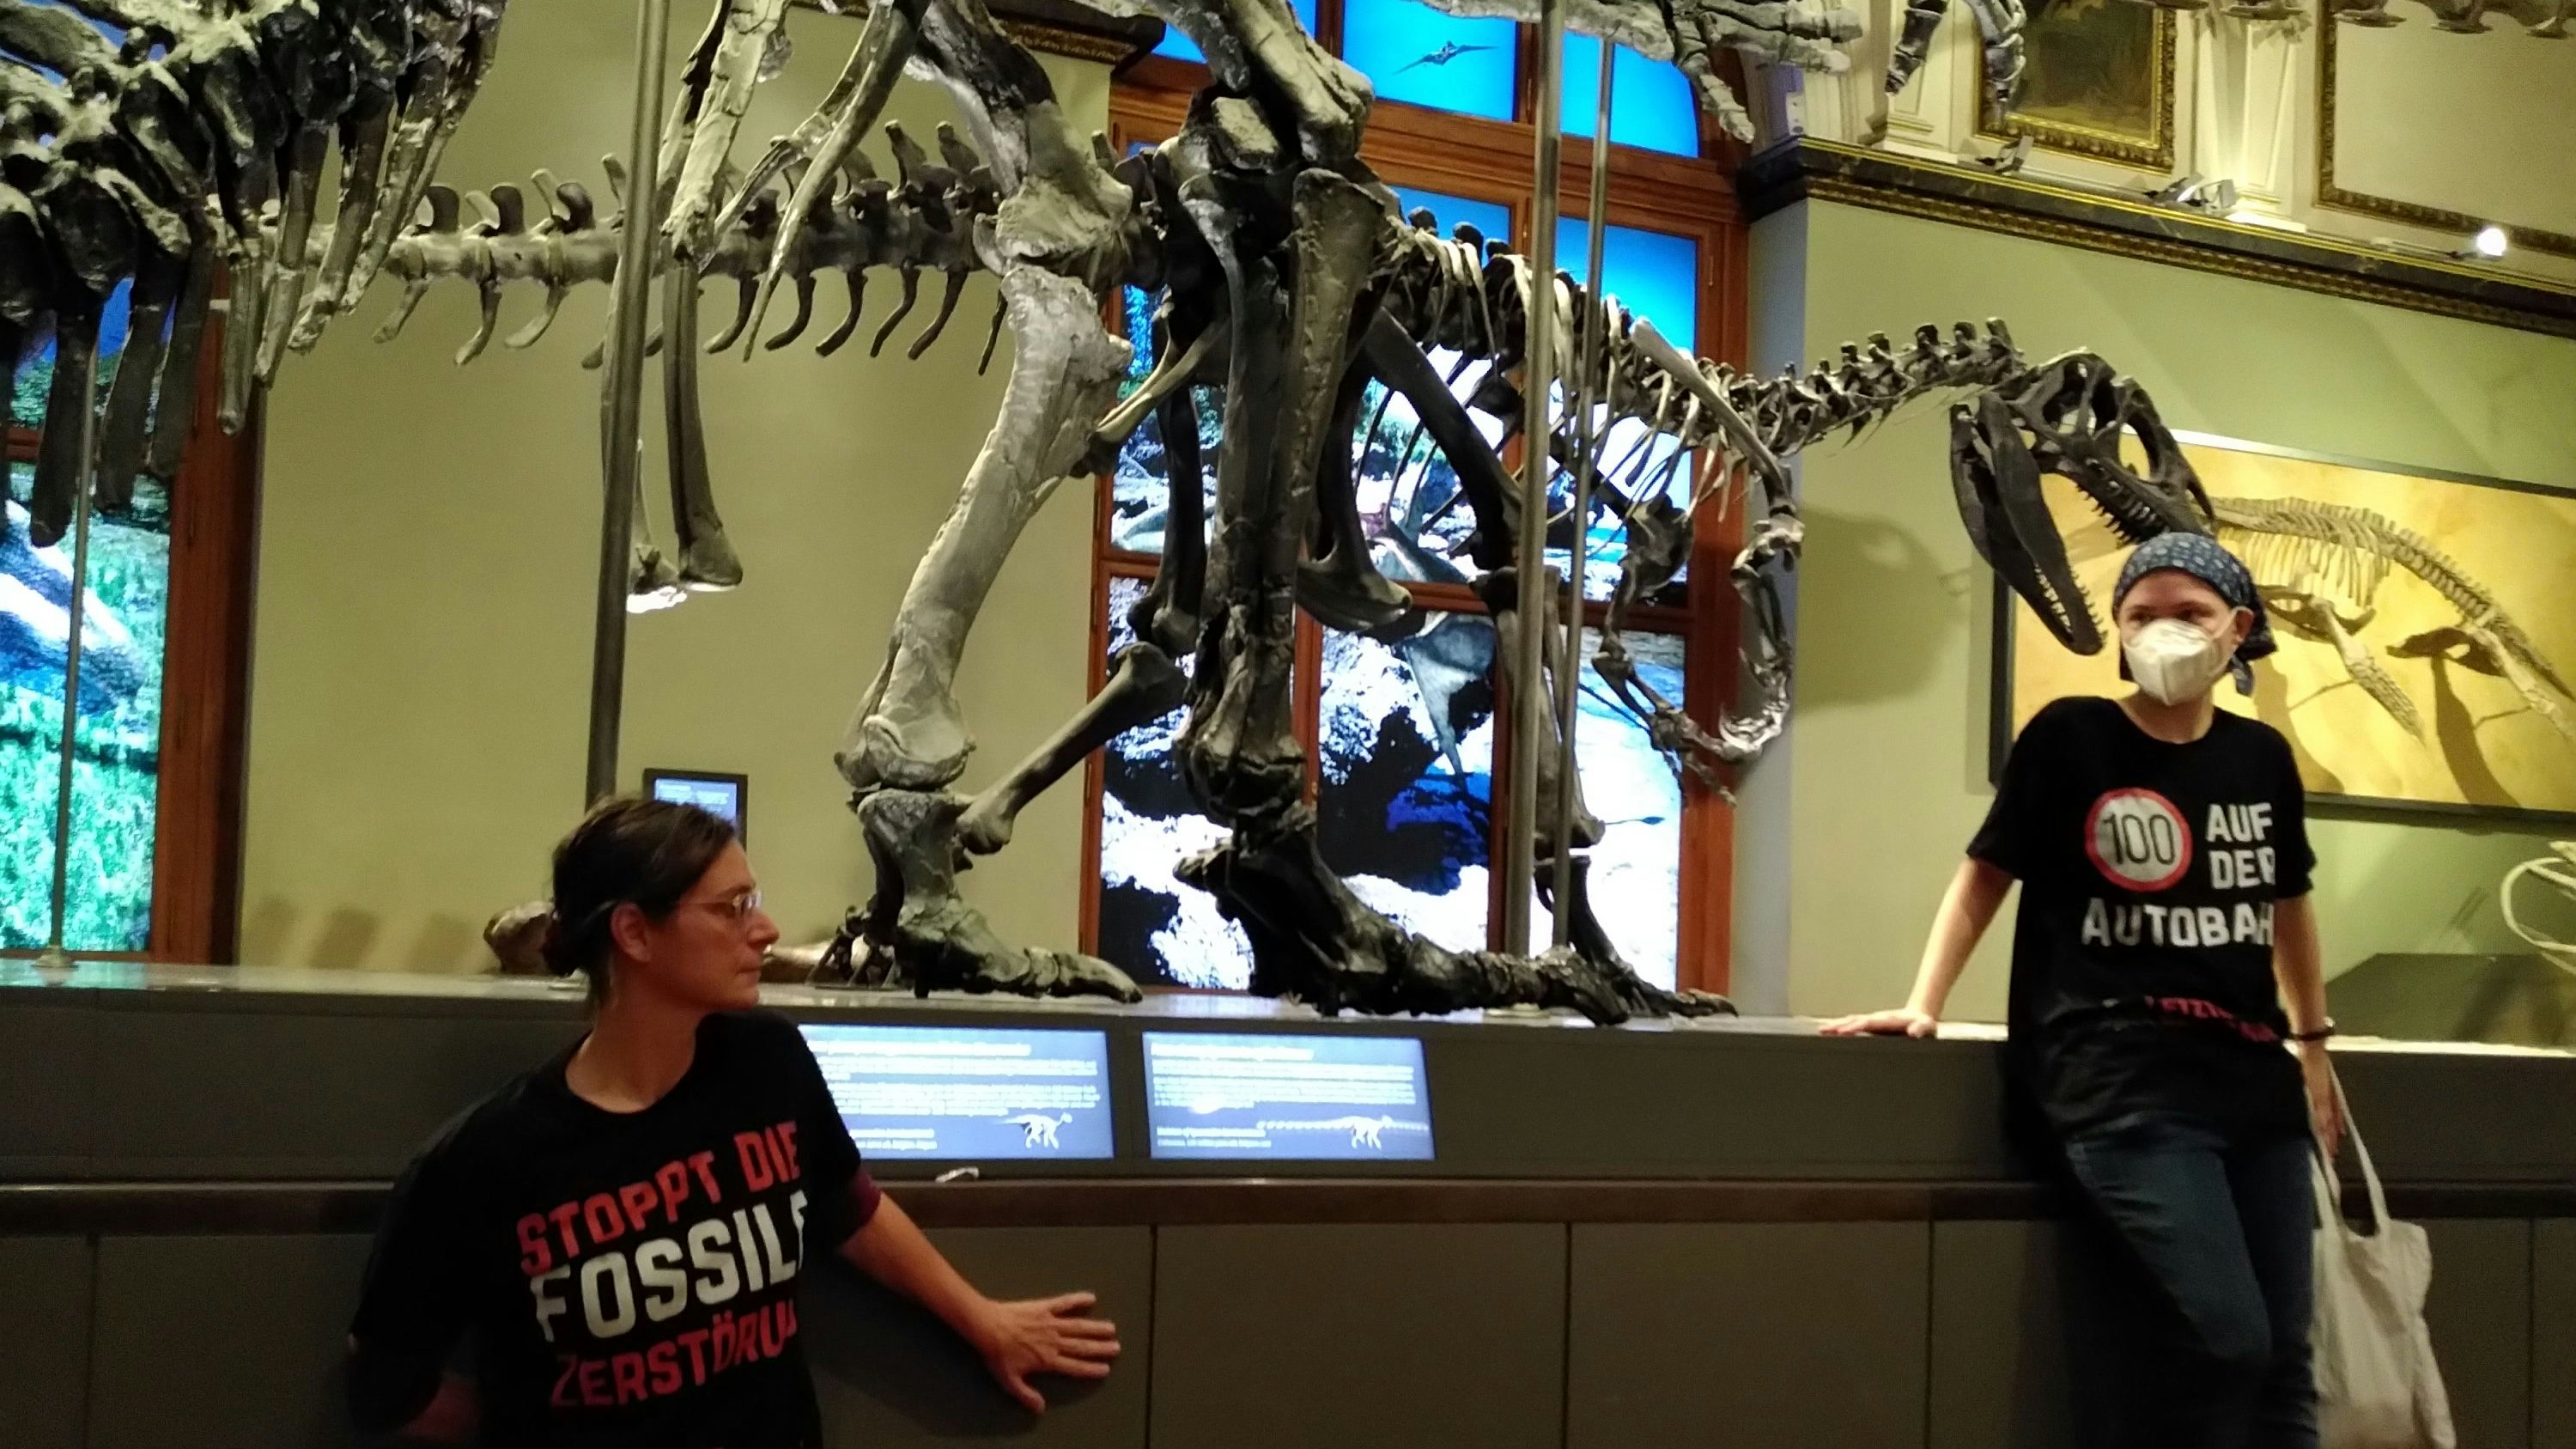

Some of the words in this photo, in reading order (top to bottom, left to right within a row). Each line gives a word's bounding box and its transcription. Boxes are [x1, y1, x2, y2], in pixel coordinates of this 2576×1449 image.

[2103, 813, 2175, 865] 100
[2206, 802, 2273, 843] AUF
[2208, 846, 2275, 890] DER
[516, 1151, 722, 1278] STOPPT
[733, 1120, 801, 1192] DIE
[550, 1299, 798, 1408] ZERSTÖRU
